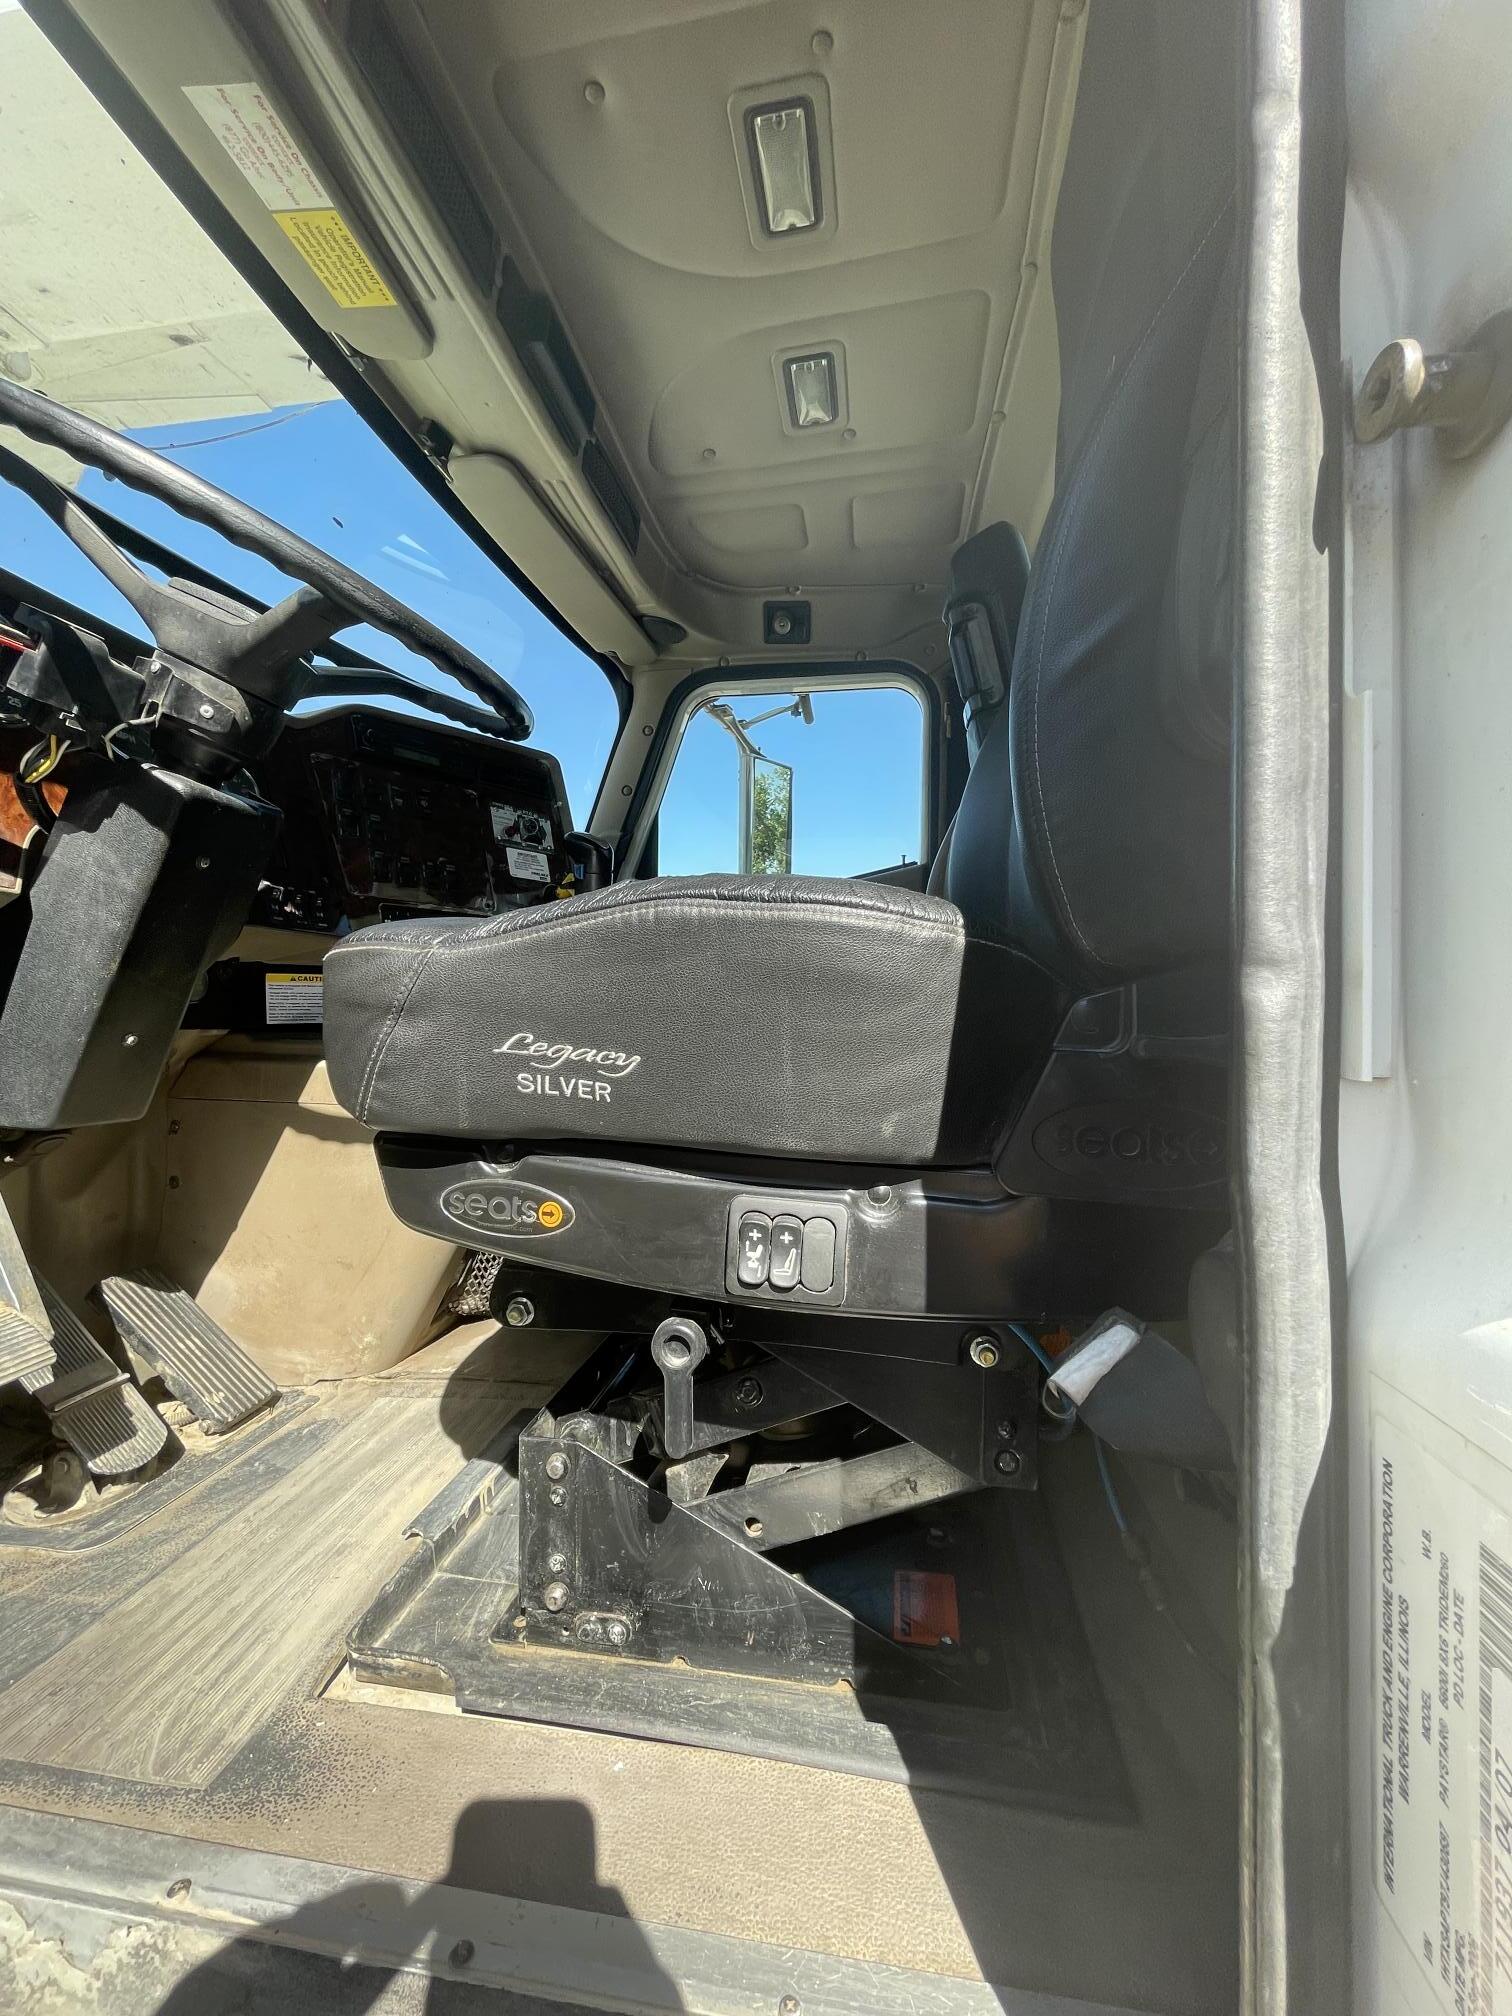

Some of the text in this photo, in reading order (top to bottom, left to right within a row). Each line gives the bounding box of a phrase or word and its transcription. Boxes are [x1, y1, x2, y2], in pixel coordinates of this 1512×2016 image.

[341, 234, 379, 285] IMPORTANT
[493, 1033, 641, 1075] Legacy
[517, 1073, 612, 1103] SILVER
[449, 1191, 538, 1224] seats
[1421, 1529, 1431, 1560] W.B.
[1453, 1587, 1464, 1638] DATE
[1382, 1457, 1395, 1895] INTERNATIONAL TRUCK AND ENGINE CORPORATION
[1453, 1644, 1464, 1683] LOC
[1398, 1594, 1410, 1805] WARRENVILLE, ILLINOIS
[1453, 1682, 1464, 1711] PD
[1421, 1689, 1431, 1745] MODEL
[1424, 1931, 1433, 1967] VIN
